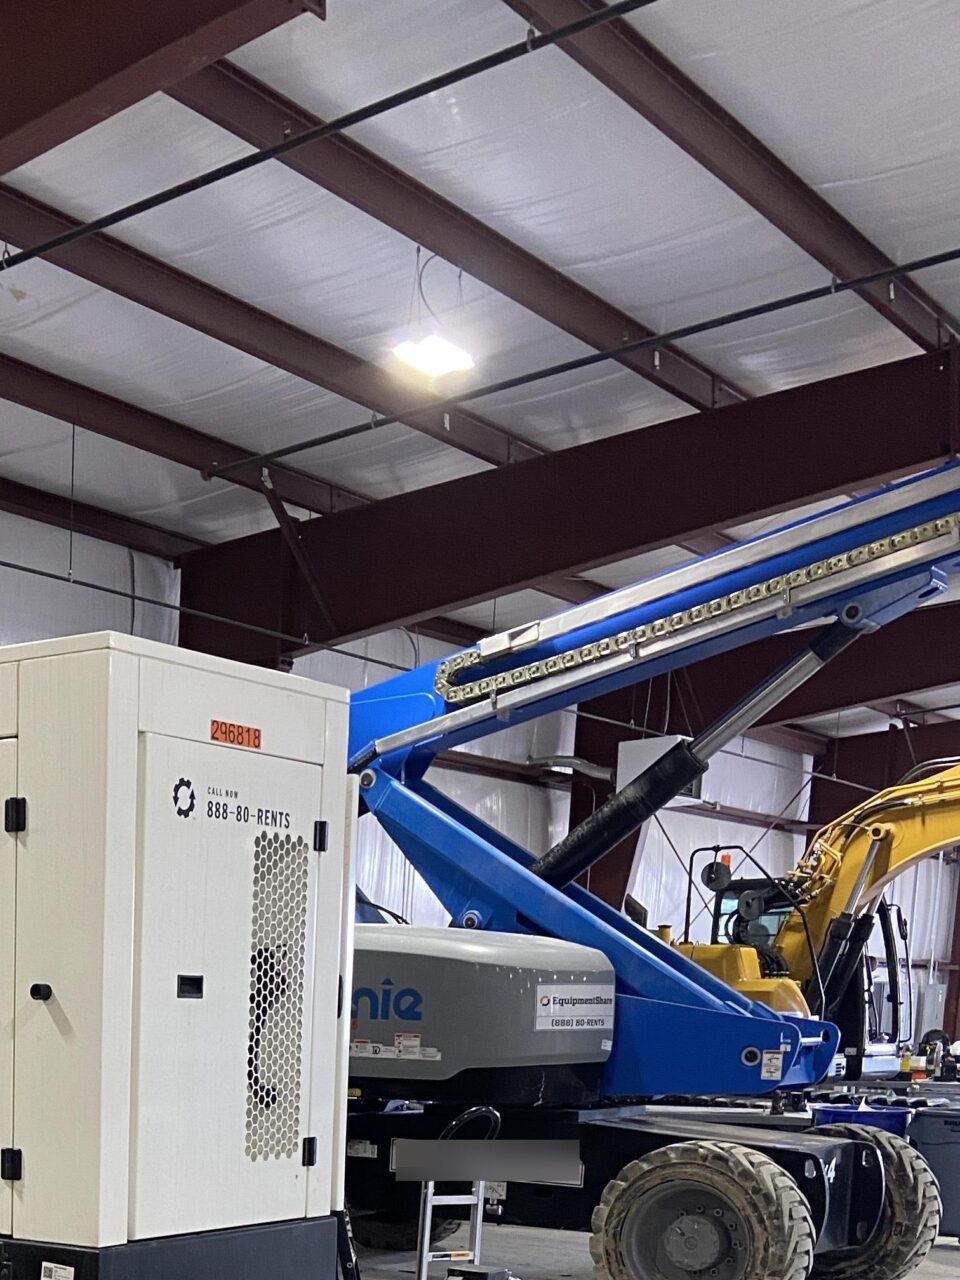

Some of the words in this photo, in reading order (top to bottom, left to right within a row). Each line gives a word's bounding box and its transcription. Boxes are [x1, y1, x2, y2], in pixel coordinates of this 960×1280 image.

[211, 720, 260, 748] 296818
[207, 786, 223, 797] CALL
[225, 789, 239, 799] NOW
[207, 801, 291, 829] 888-80-RENTS
[351, 979, 423, 1021] nie
